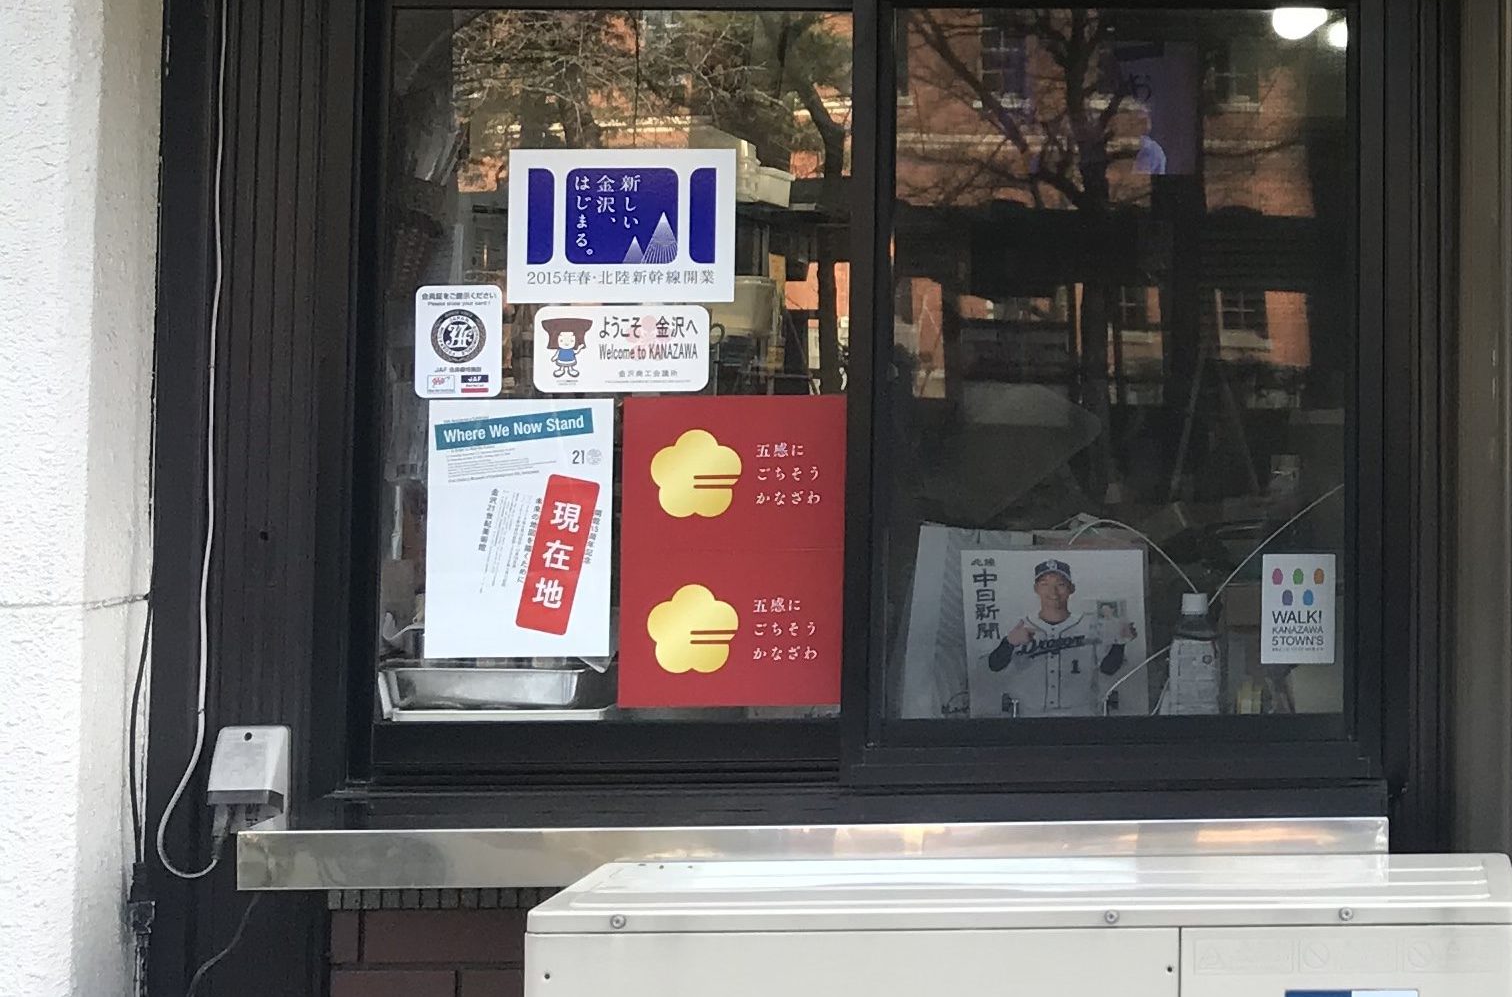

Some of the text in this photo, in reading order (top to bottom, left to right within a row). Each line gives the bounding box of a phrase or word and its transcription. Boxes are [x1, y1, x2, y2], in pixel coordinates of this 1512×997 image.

[619, 174, 641, 229] 新しい
[574, 175, 594, 256] はじまる。
[599, 315, 699, 338] ようこそ 金沢へ
[599, 343, 699, 361] Welcome to KANAZAWA
[443, 414, 585, 444] Where We Now Stand
[571, 449, 586, 465] 21
[755, 442, 804, 459] 五感に
[757, 466, 820, 481] ごちそう
[755, 490, 821, 506] かなざわ
[531, 500, 582, 609] 現在地
[752, 597, 801, 613] 五感に
[972, 568, 1001, 640] 中日新聞
[1271, 609, 1323, 625] WALK!
[753, 620, 817, 637] ごちそう
[1271, 625, 1324, 635] KANAZAWA
[752, 646, 818, 661] かなざわ
